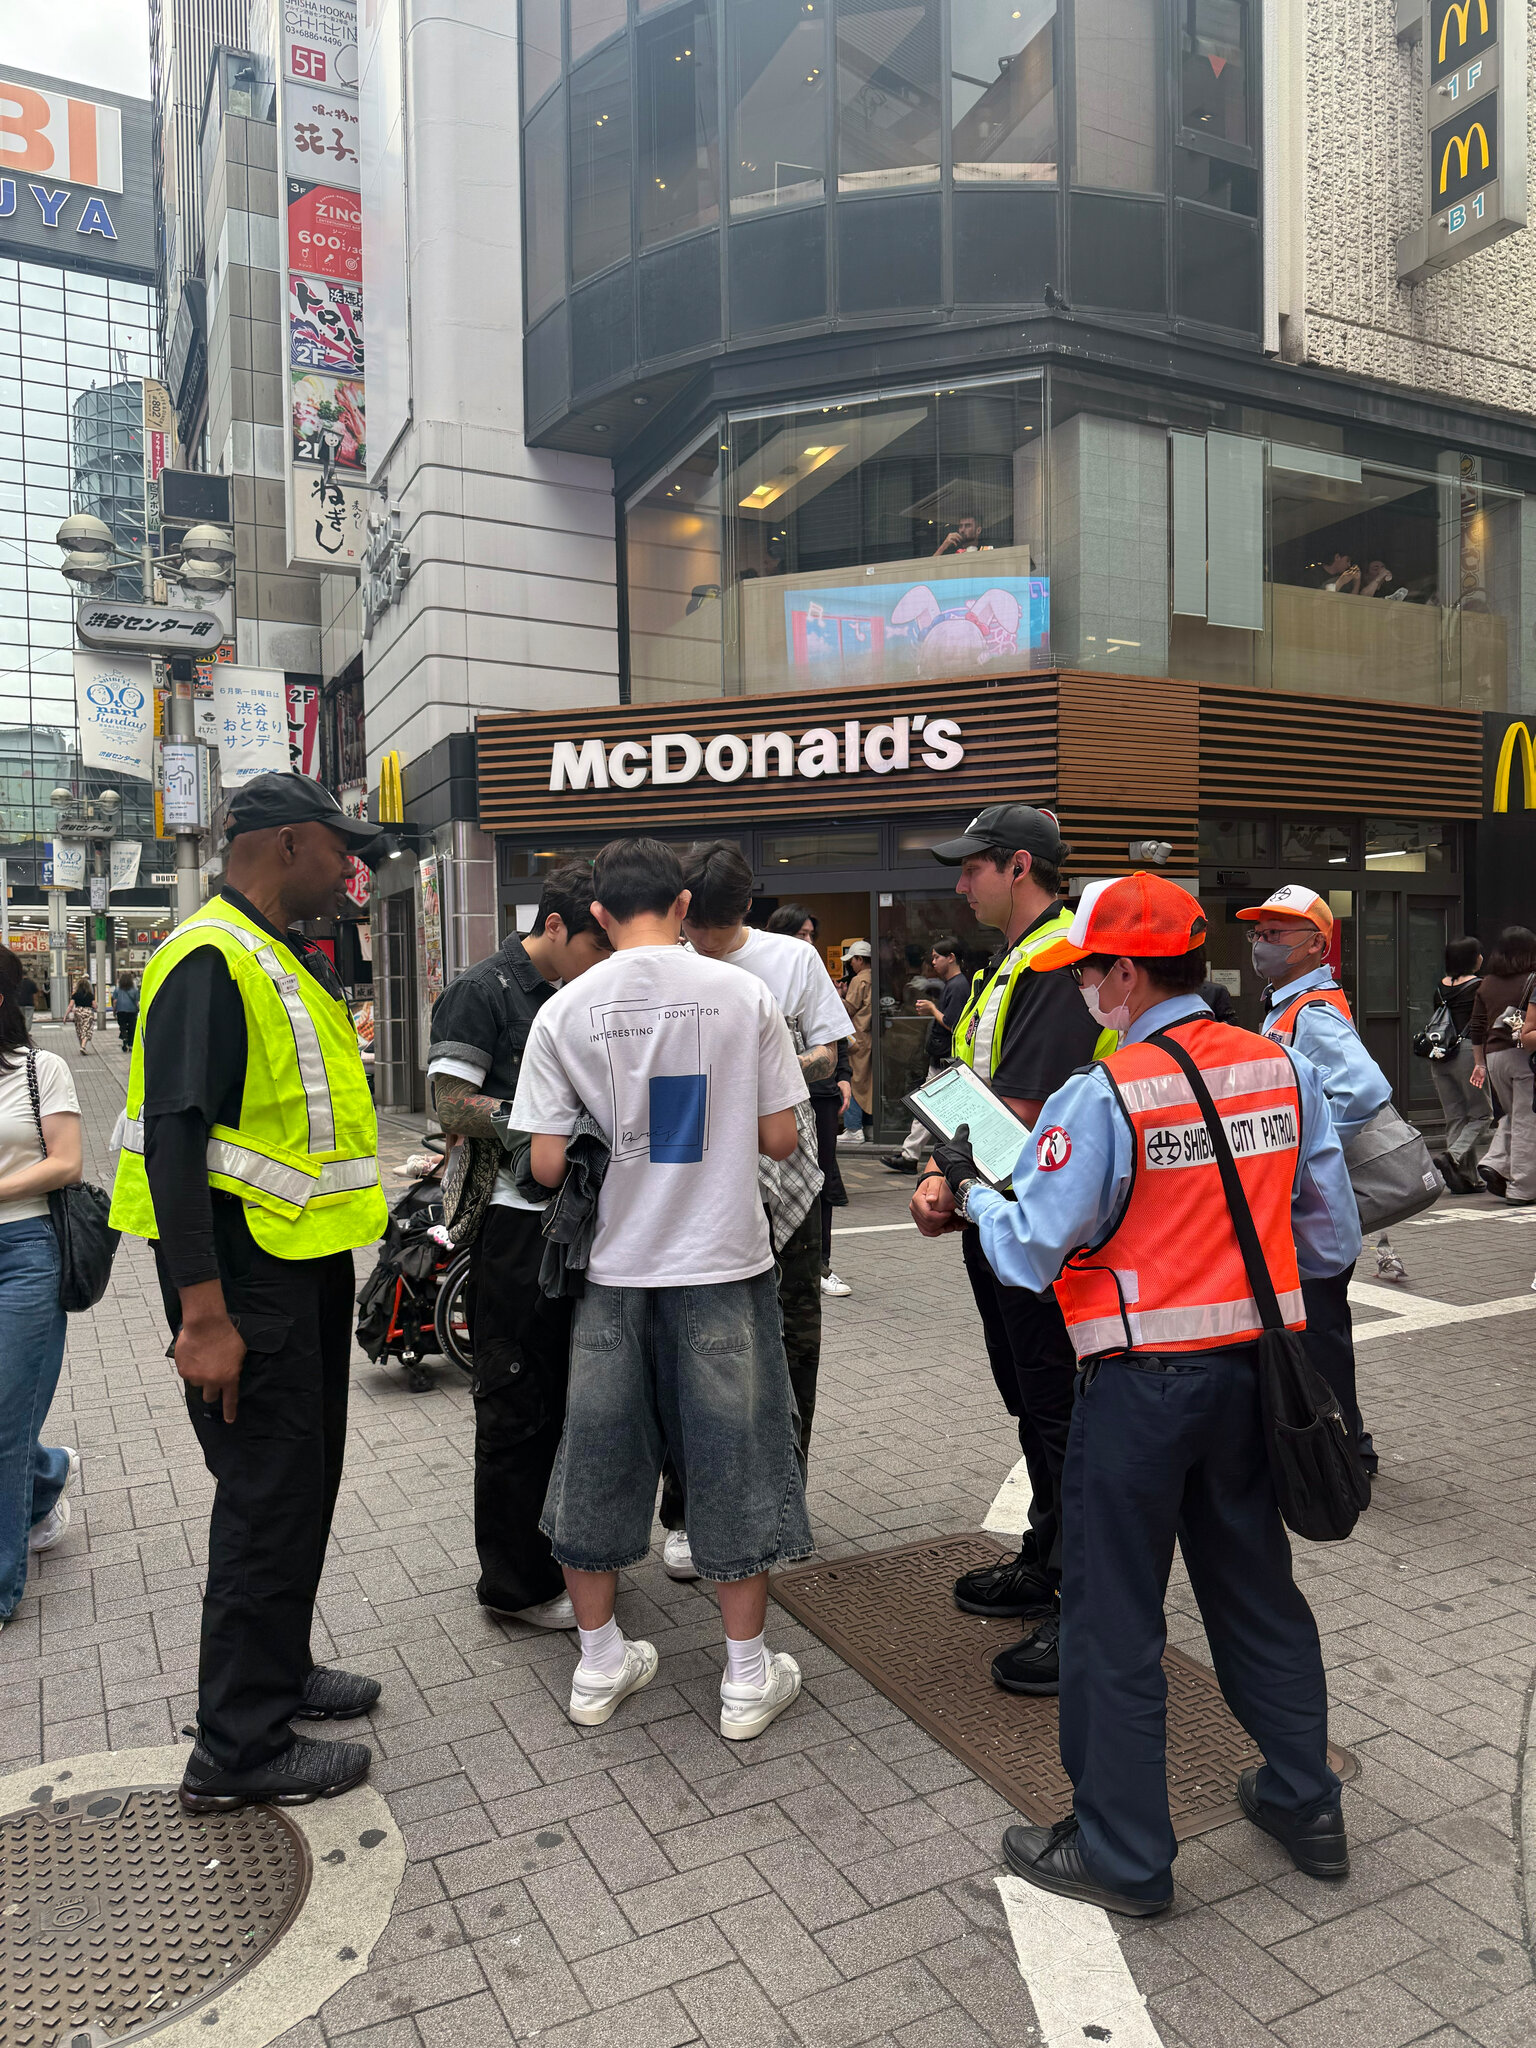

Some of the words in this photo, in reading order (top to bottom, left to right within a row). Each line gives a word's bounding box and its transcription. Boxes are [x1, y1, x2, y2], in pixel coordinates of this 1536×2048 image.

[320, 5, 357, 22] HOOKAH
[294, 49, 323, 77] 5F
[291, 183, 306, 194] 3F
[315, 203, 361, 224] ZINO
[298, 230, 341, 249] 600
[296, 346, 326, 365] 2F
[311, 476, 347, 555] ねぎし
[85, 612, 215, 637] 渋谷センター街
[220, 648, 231, 658] 3F
[290, 688, 315, 703] 2F
[236, 701, 268, 716] 渋谷
[223, 718, 283, 734] おとなり
[224, 734, 285, 749] サンデー
[548, 714, 965, 792] McDonald's
[664, 1009, 695, 1020] DON'T
[700, 1008, 720, 1016] FOR
[590, 1027, 654, 1043] INTERESTING
[1231, 1118, 1257, 1153] CITY
[1260, 1111, 1296, 1148] PATROL
